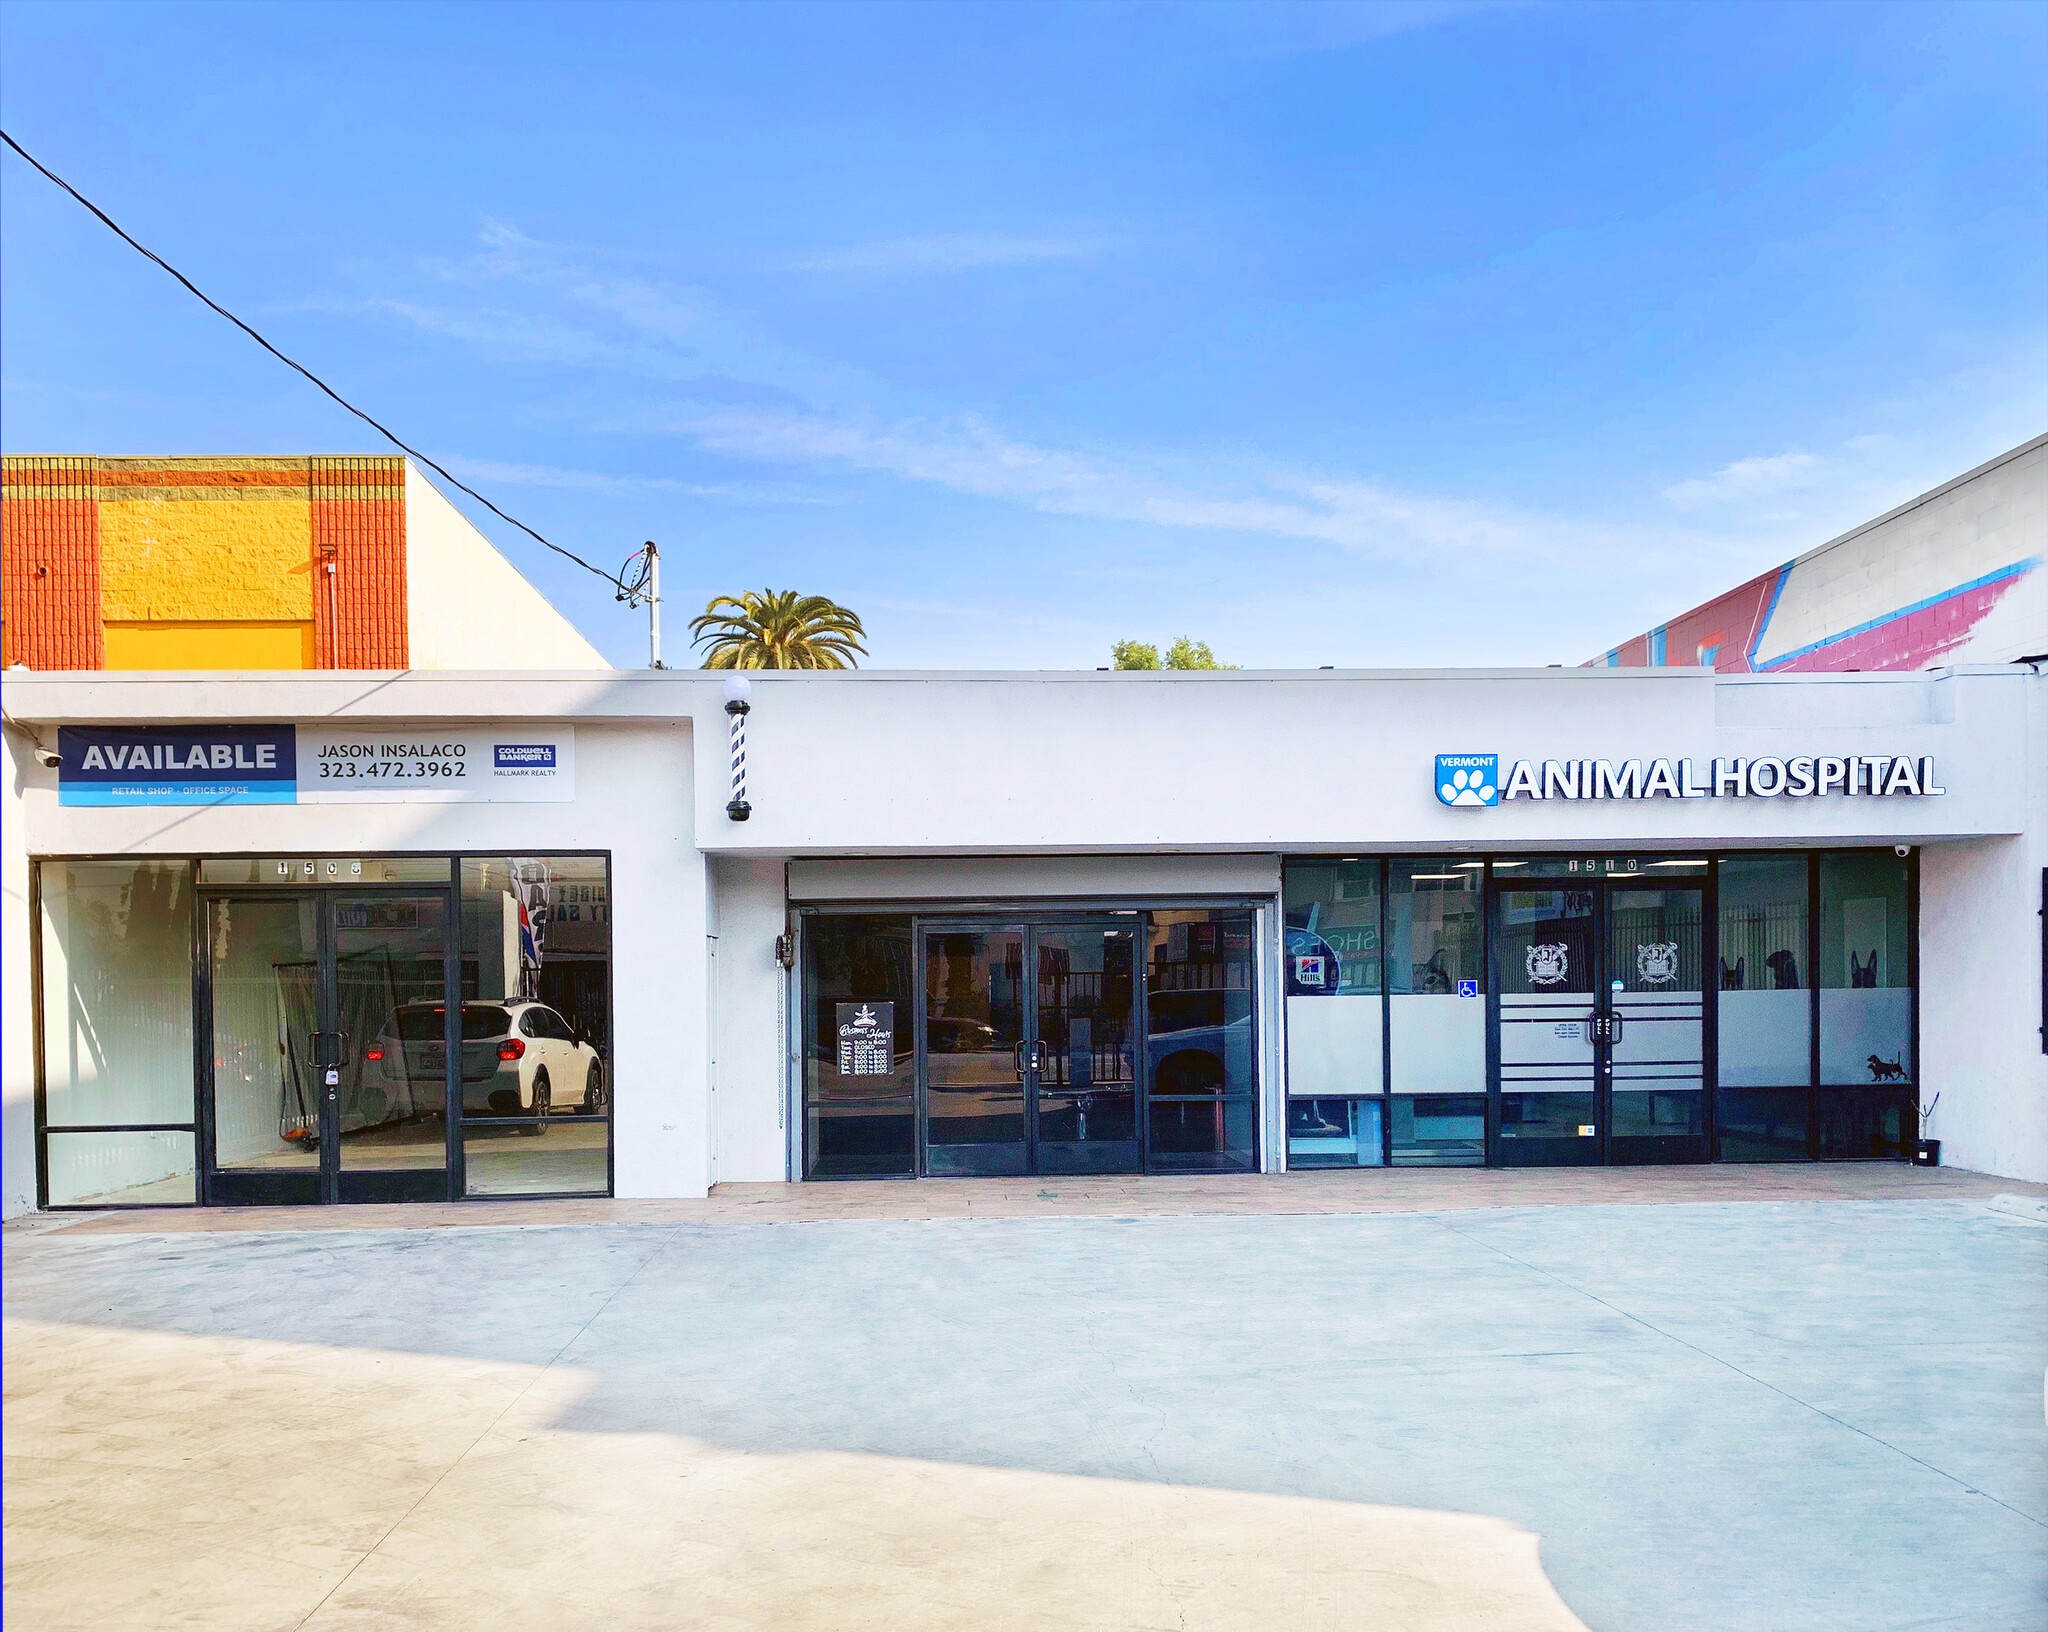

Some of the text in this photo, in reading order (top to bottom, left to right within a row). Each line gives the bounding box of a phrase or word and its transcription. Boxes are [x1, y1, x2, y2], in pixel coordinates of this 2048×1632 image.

[81, 744, 277, 770] AVAILABLE
[318, 744, 467, 758] JASON INSALACO
[1440, 757, 1495, 767] VERMONT
[319, 761, 467, 778] 323.472.3962
[494, 769, 557, 777] HALLMARK REALTY
[1502, 756, 1946, 800] ANIMAL HOSPITAL
[112, 787, 145, 796] RETAIL
[147, 787, 174, 795] SHOP
[183, 786, 216, 795] OFFICE
[218, 786, 249, 794] SPACE
[1570, 860, 1636, 871] 1510
